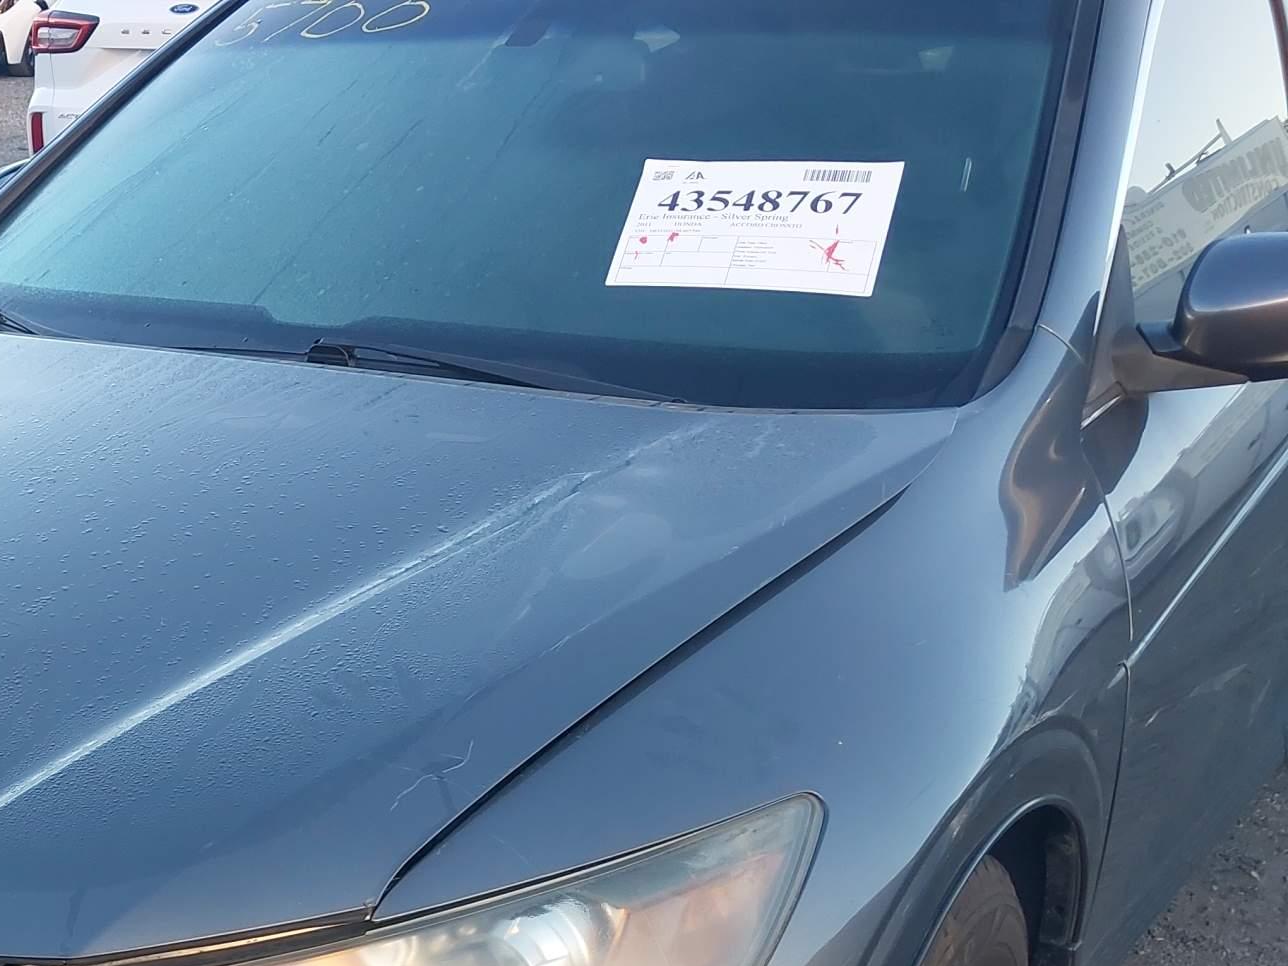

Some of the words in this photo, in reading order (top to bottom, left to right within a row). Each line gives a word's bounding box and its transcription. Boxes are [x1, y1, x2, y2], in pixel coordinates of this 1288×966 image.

[656, 189, 863, 215] 43548767
[720, 213, 751, 221] Silver
[753, 213, 789, 222] Spring
